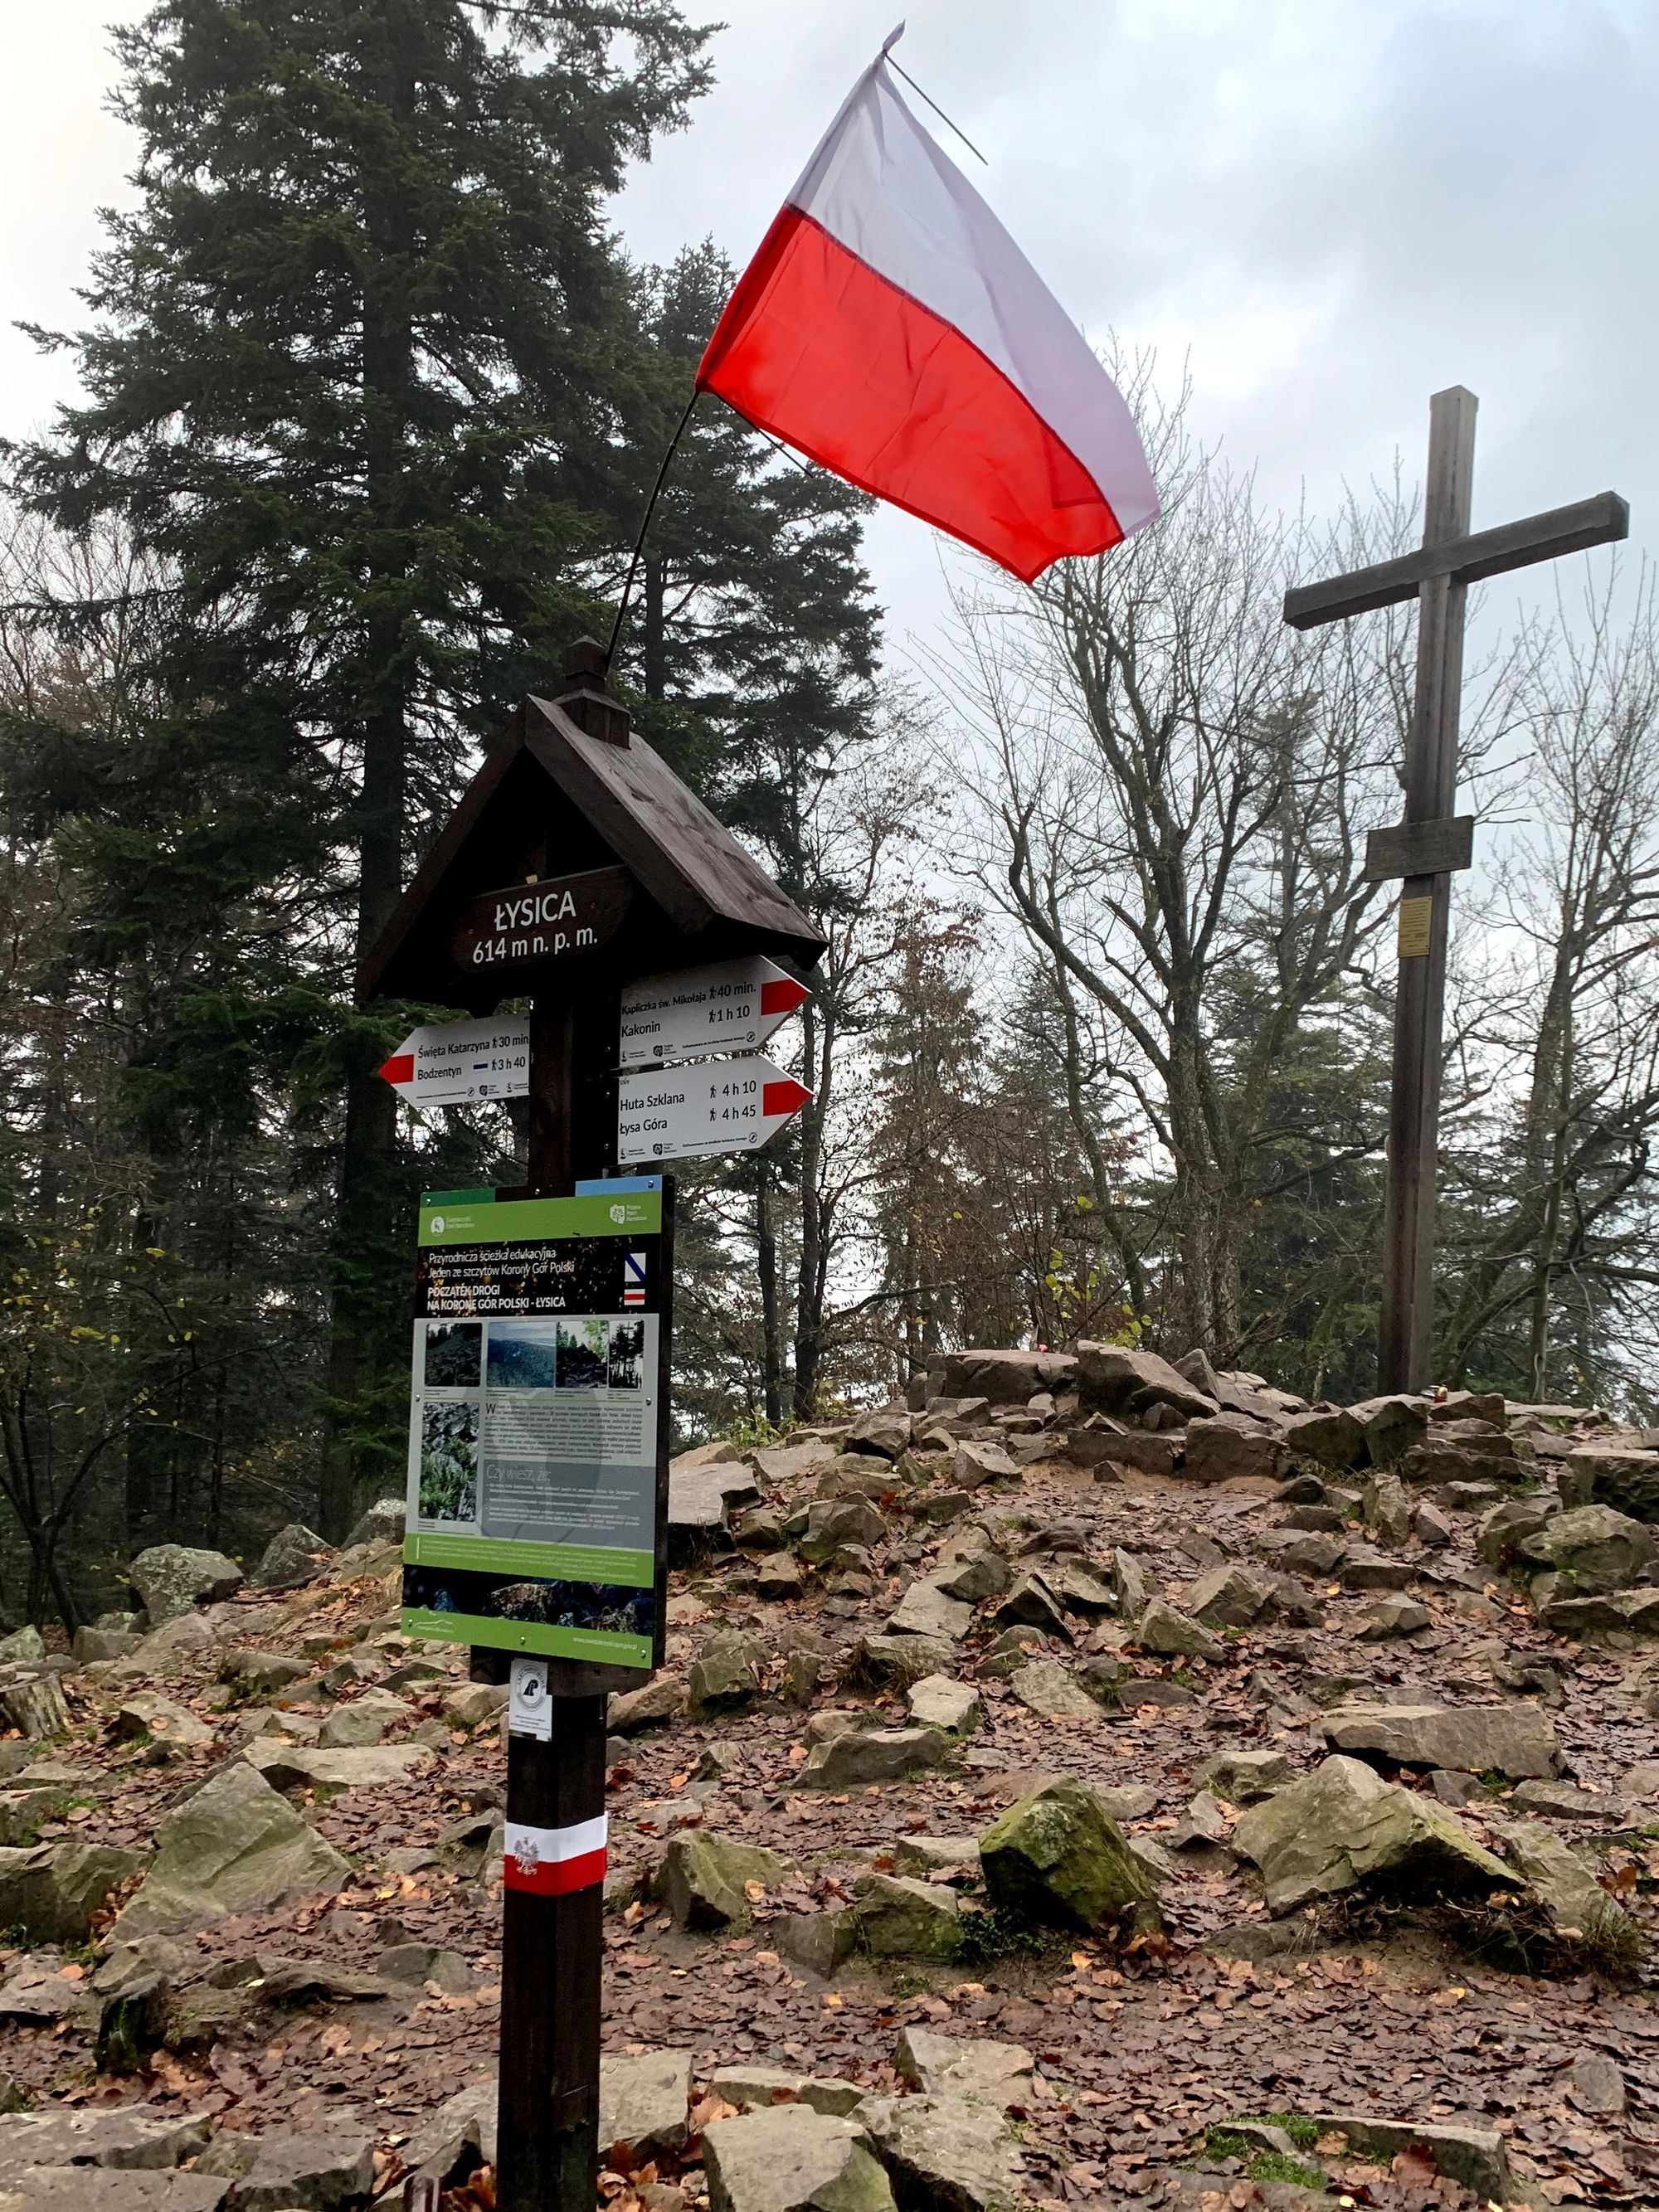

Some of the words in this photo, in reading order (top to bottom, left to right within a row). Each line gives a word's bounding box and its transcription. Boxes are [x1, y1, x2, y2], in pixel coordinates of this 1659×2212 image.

[494, 890, 577, 931] ŁYSICA
[473, 937, 507, 964] 614
[511, 939, 528, 958] m
[533, 936, 549, 954] n.
[554, 931, 571, 955] p.
[576, 927, 598, 946] m.
[621, 1000, 657, 1015] Kapliczka
[658, 999, 671, 1009] św.
[673, 992, 707, 1006] Mikołaja
[717, 984, 732, 998] 40
[733, 981, 757, 996] min.
[620, 1020, 661, 1038] Kakonin
[718, 1009, 723, 1022] 1
[726, 1008, 733, 1020] h
[737, 1004, 751, 1019] 10
[418, 1045, 446, 1059] Święta
[448, 1039, 490, 1055] Katarzyna
[499, 1035, 511, 1048] 30
[417, 1066, 462, 1081] Bodzentyn
[498, 1060, 504, 1071] 3
[506, 1058, 512, 1070] h
[513, 1056, 526, 1068] 40
[620, 1098, 645, 1111] Huta
[647, 1093, 685, 1107] Szklana
[722, 1084, 730, 1096] 4
[732, 1082, 739, 1096] h
[742, 1080, 757, 1094] 10
[620, 1122, 640, 1136] Łysa
[643, 1116, 668, 1131] Góra
[722, 1108, 730, 1121] 4
[732, 1106, 739, 1120] h
[742, 1104, 757, 1118] 45
[429, 1251, 478, 1266] Przyrodnicza
[479, 1248, 508, 1262] ścieżka
[509, 1247, 557, 1262] edukacyjna
[428, 1266, 451, 1279] Jeden
[452, 1269, 462, 1277] ze
[463, 1265, 500, 1278] szczytów
[501, 1263, 531, 1276] Korony
[532, 1262, 548, 1274] Gór
[550, 1261, 575, 1273] Polski
[427, 1300, 440, 1311] NA
[440, 1298, 476, 1311] KORONĘ
[478, 1296, 497, 1310] GÓR
[499, 1297, 529, 1309] POLSKI
[536, 1296, 566, 1308] ŁYSICA
[428, 1285, 472, 1299] POCZĄTEK
[472, 1284, 500, 1296] DROGI
[486, 1464, 504, 1485] Czy
